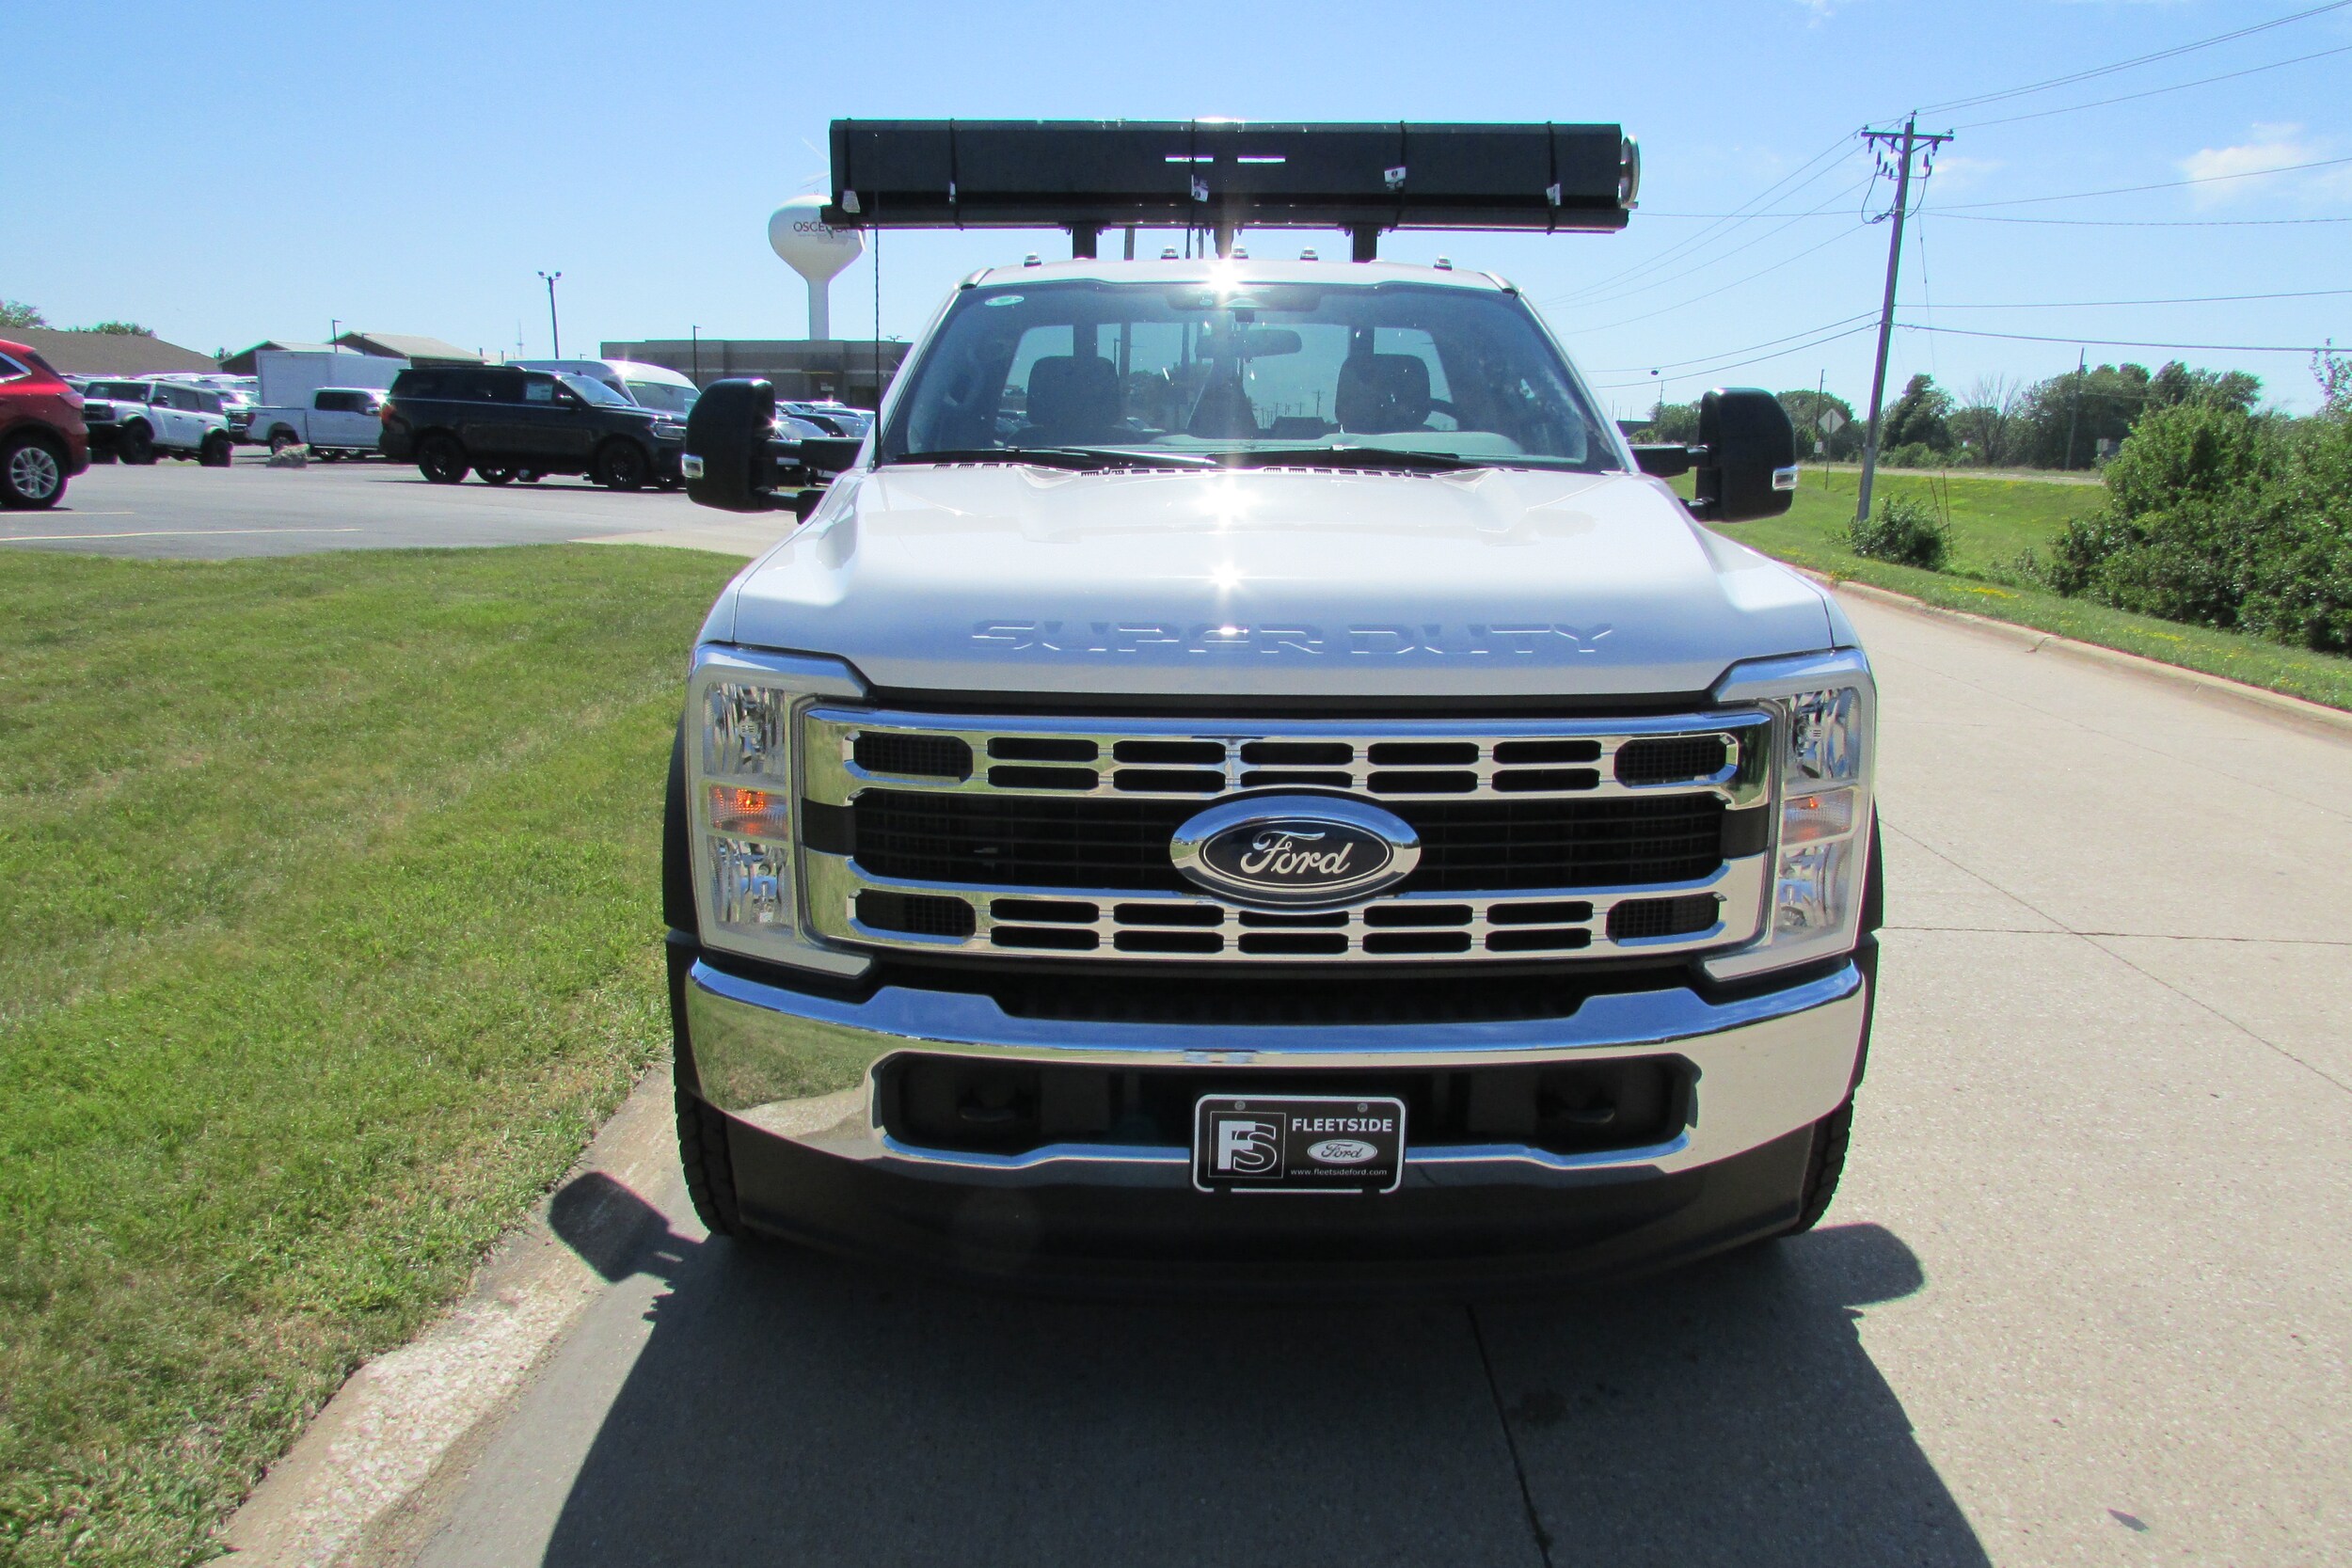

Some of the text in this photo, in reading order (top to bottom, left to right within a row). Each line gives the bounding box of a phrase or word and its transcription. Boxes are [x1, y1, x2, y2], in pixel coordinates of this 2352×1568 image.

[793, 221, 849, 233] OSCE
[969, 620, 1614, 656] SUPER DUTY
[1241, 831, 1354, 875] Ford
[1292, 1118, 1393, 1132] FLEETSIDE
[1218, 1120, 1278, 1173] FS
[1321, 1143, 1363, 1160] Ford
